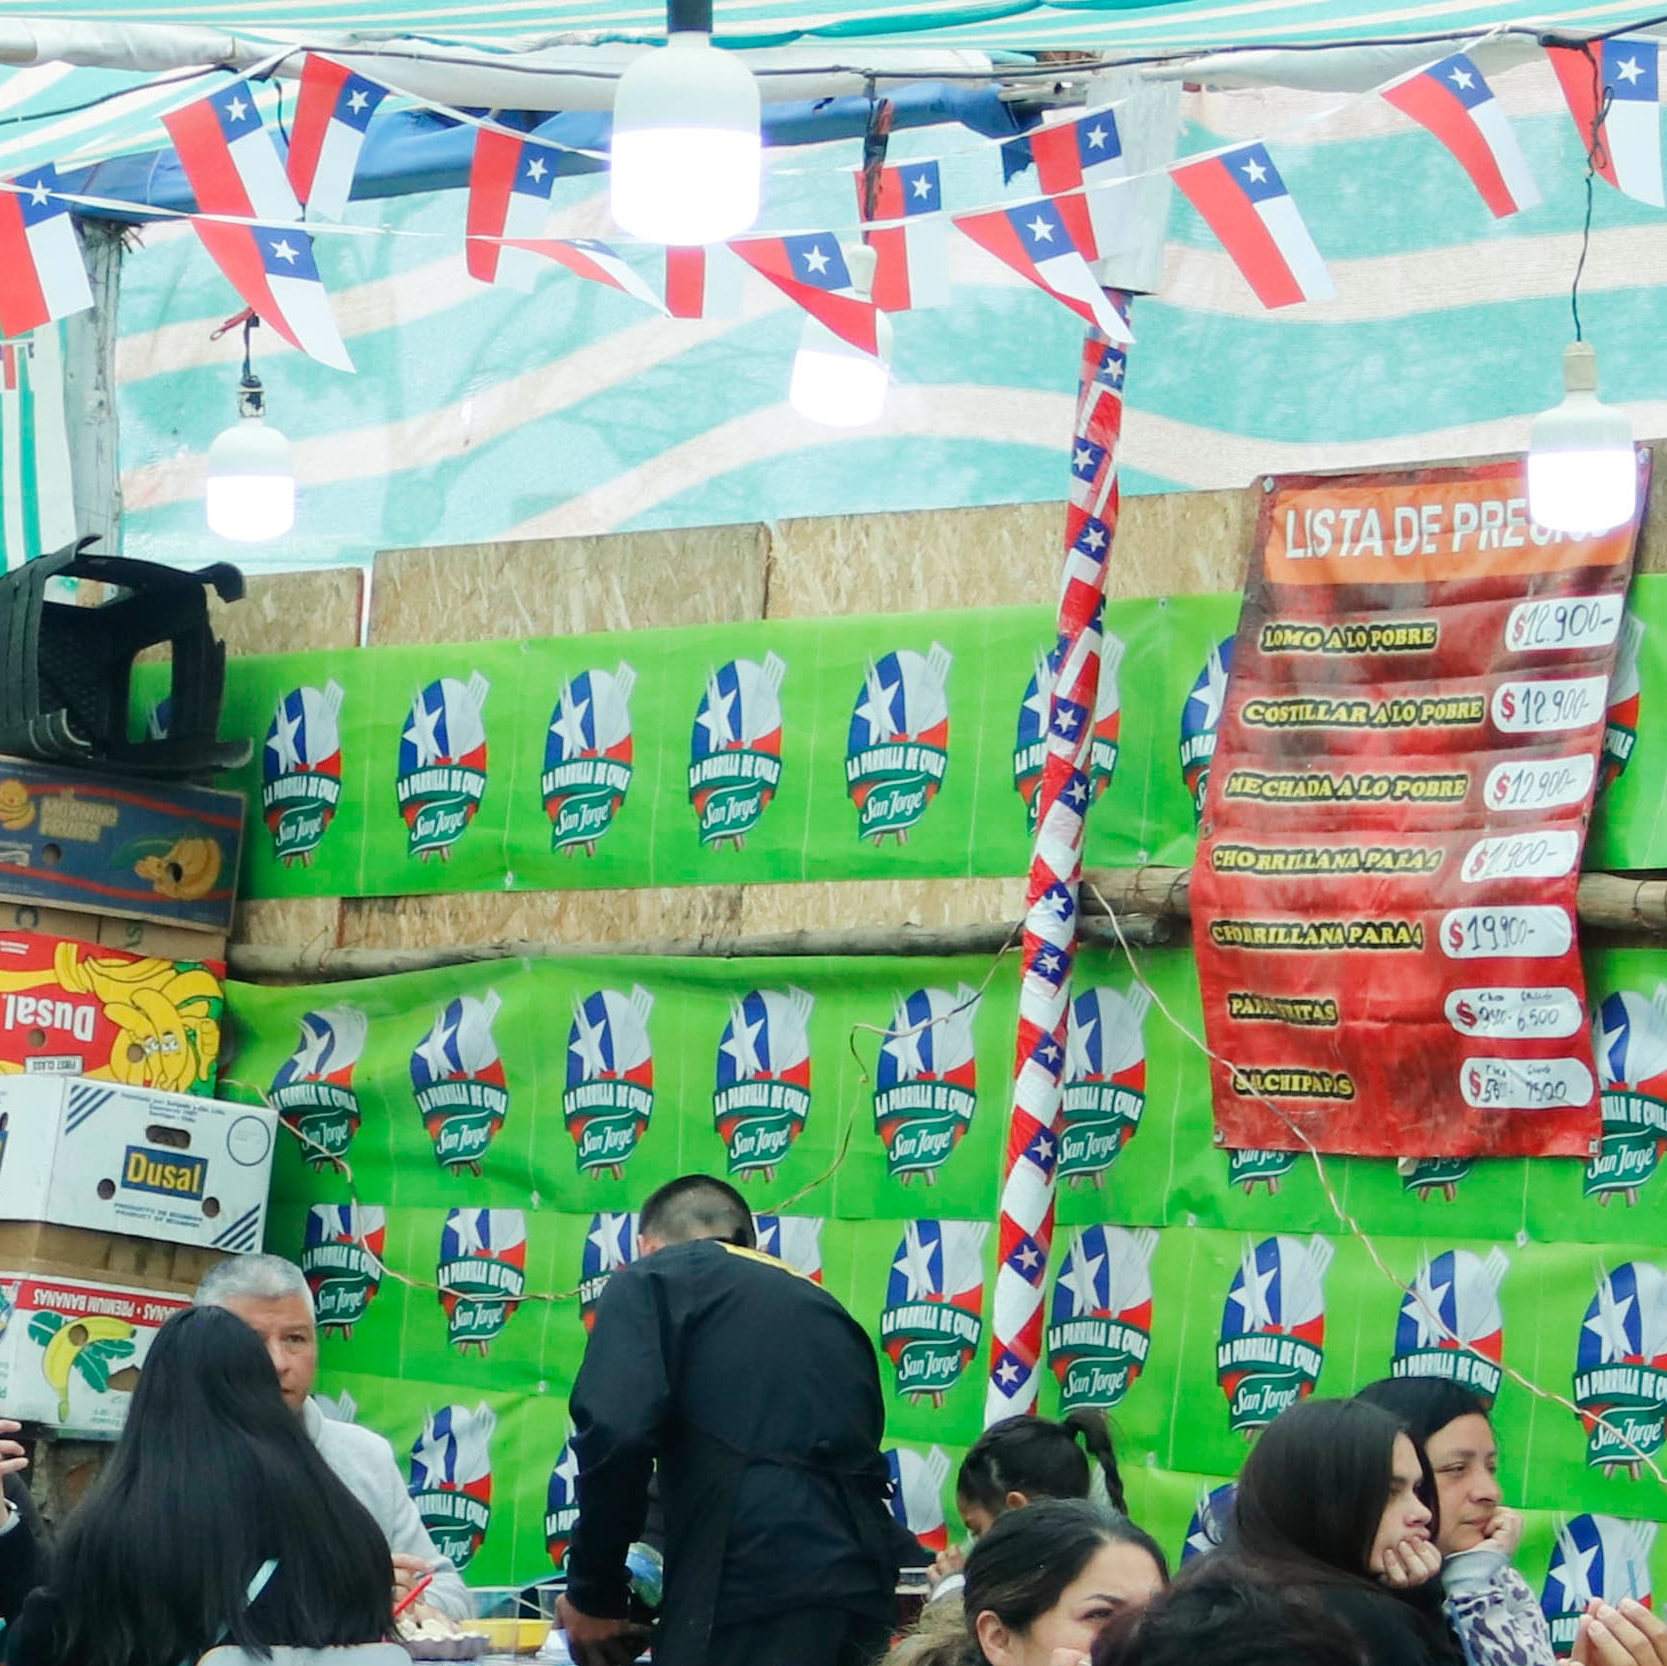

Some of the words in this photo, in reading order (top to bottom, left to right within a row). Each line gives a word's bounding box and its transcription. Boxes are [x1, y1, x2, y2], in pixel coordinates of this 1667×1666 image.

[1285, 505, 1383, 558] LISTA
[1393, 504, 1443, 555] DE
[1264, 627, 1323, 649] LOMO
[1325, 628, 1343, 650] A
[1345, 628, 1367, 648] LO
[1369, 625, 1436, 648] POBRE
[1246, 703, 1368, 722] COSTILLAR
[1372, 704, 1388, 723] A
[1392, 703, 1414, 722] LO
[1420, 700, 1483, 721] POBRE
[595, 762, 606, 785] DE
[607, 762, 632, 791] CHILE
[742, 753, 754, 776] DE
[754, 754, 781, 785] CHILE
[905, 747, 919, 770] DE
[919, 749, 946, 780] CHILE
[449, 769, 462, 792] DE
[462, 771, 486, 799] CHILE
[1227, 776, 1334, 798] MECHADA
[1335, 778, 1355, 798] A
[1357, 779, 1389, 798] LO
[1393, 779, 1466, 798] POBRE
[555, 810, 579, 835] San
[577, 800, 610, 831] Jorge
[702, 801, 726, 829] San
[725, 792, 760, 823] Jorge
[862, 793, 889, 820] San
[886, 785, 925, 816] Jorge
[410, 813, 435, 839] San
[433, 805, 466, 832] Jorge
[1213, 849, 1363, 871] CHORRILLANA
[1365, 851, 1424, 870] PARA
[1212, 925, 1345, 945] CHORRILLANA
[1348, 926, 1410, 945] PARA
[4, 994, 96, 1043] Dusal
[770, 1084, 783, 1109] DE
[783, 1087, 810, 1117] CHILE
[934, 1086, 947, 1110] DE
[948, 1088, 975, 1119] CHILE
[730, 1131, 754, 1159] San
[753, 1125, 790, 1156] Jorge
[890, 1133, 917, 1161] San
[915, 1126, 954, 1157] Jorge
[126, 1152, 202, 1194] Dusal
[1587, 1156, 1618, 1180] San
[1616, 1141, 1655, 1177] Jorge
[32, 1288, 87, 1312] BANANAS
[87, 1294, 136, 1318] PREMIUM
[940, 1308, 952, 1332] DE
[953, 1311, 981, 1345] CHILE
[1107, 1322, 1121, 1347] DE
[1121, 1326, 1149, 1361] CHILE
[899, 1352, 925, 1380] San
[924, 1346, 961, 1377] Jorge
[1063, 1369, 1092, 1398] San
[1090, 1364, 1127, 1397] Jorge
